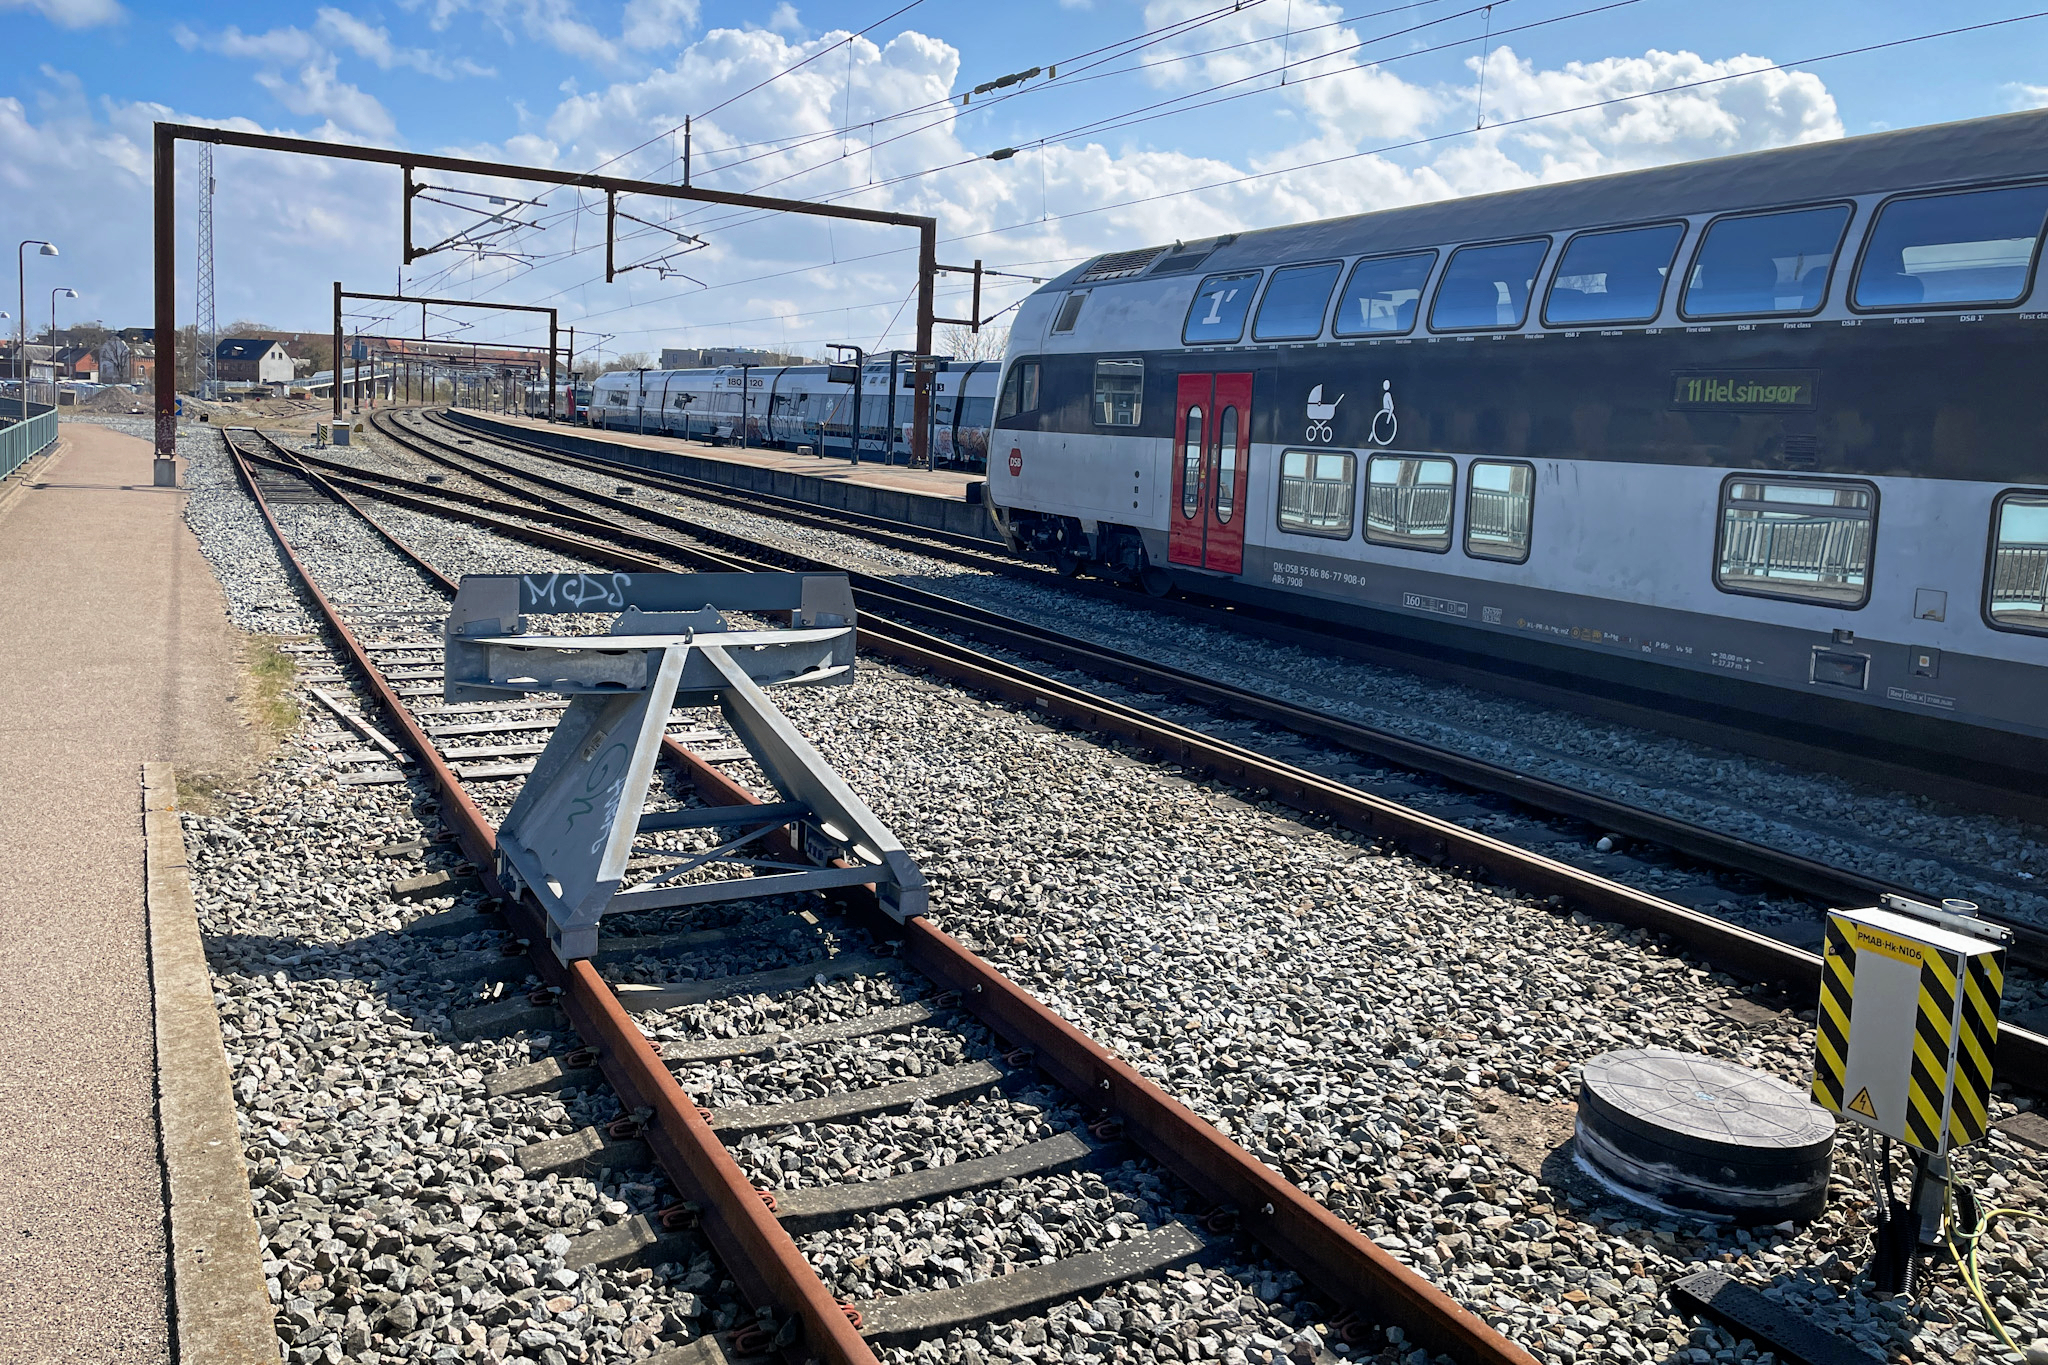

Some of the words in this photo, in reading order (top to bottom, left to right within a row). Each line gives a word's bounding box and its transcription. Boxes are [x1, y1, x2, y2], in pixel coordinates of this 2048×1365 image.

[728, 378, 742, 386] 180
[750, 379, 763, 387] 120
[1688, 380, 1701, 402] 11
[1704, 380, 1801, 403] Helsingør
[1010, 456, 1022, 467] DSB
[1273, 562, 1299, 574] DK-DSB
[1300, 566, 1309, 576] 55
[1310, 568, 1319, 578] 86
[1320, 570, 1342, 582] 86-77
[1344, 574, 1366, 586] 908-0
[1272, 574, 1284, 584] ABs
[1286, 576, 1303, 588] 7908
[1406, 596, 1420, 606] 160
[1719, 652, 1736, 661] 20,00
[1718, 660, 1734, 668] 27,27
